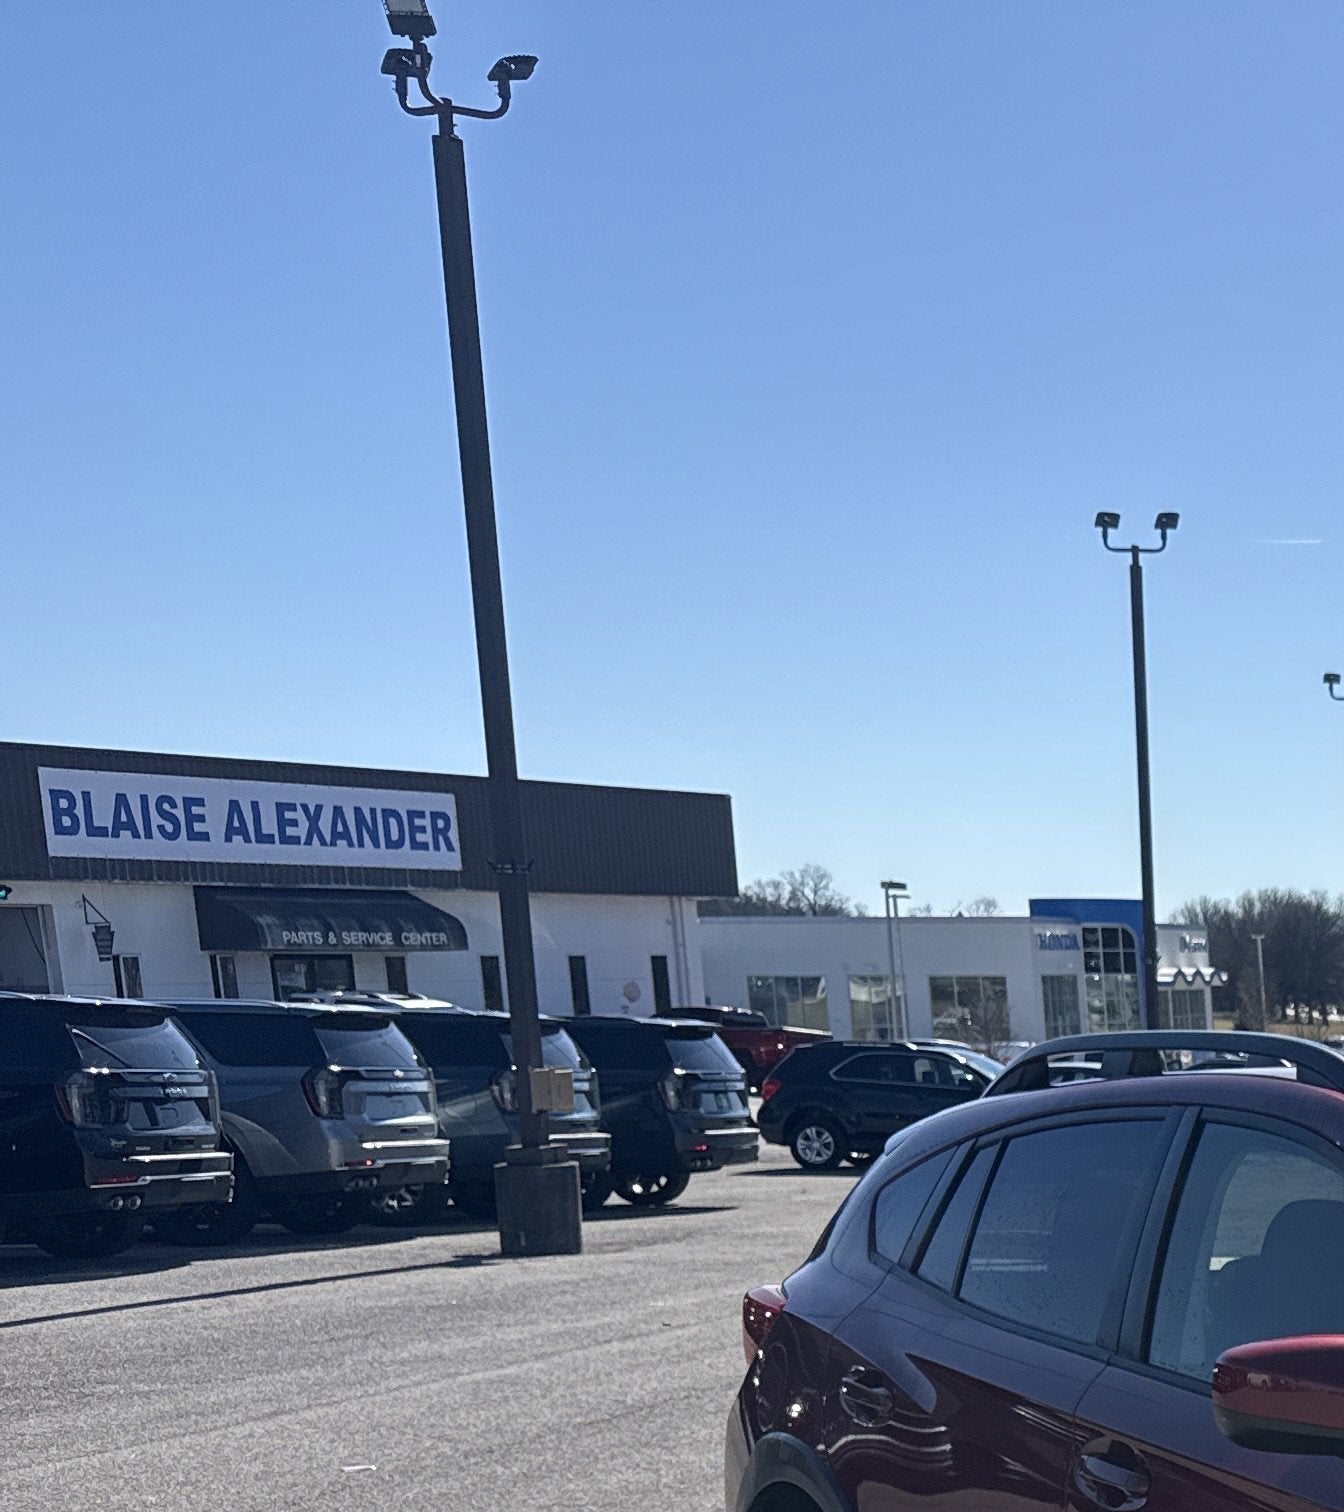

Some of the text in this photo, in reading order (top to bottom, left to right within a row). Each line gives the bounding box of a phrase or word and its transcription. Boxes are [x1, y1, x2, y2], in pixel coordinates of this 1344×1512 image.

[48, 789, 456, 852] BLAISE ALEXANDER
[282, 931, 448, 945] PARTS & SERVICE CENTER
